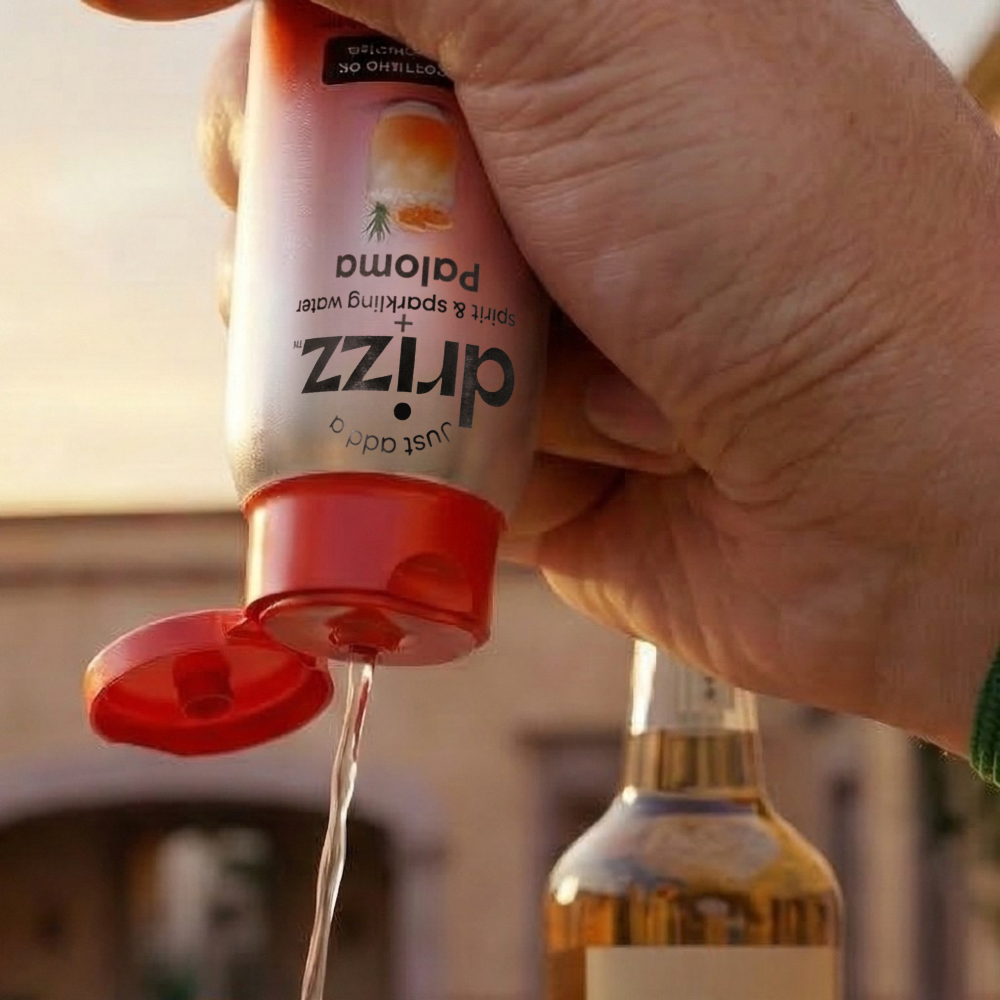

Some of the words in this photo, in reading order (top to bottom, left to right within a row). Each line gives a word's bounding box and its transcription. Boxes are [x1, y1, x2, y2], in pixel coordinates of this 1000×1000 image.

[335, 253, 480, 293] Paloma
[296, 296, 342, 313] water
[347, 290, 448, 313] sparkling
[452, 300, 466, 319] &
[471, 304, 516, 327] spirit
[301, 335, 515, 429] drizz
[329, 415, 345, 433] a
[345, 429, 397, 455] add
[403, 422, 452, 455] Just
